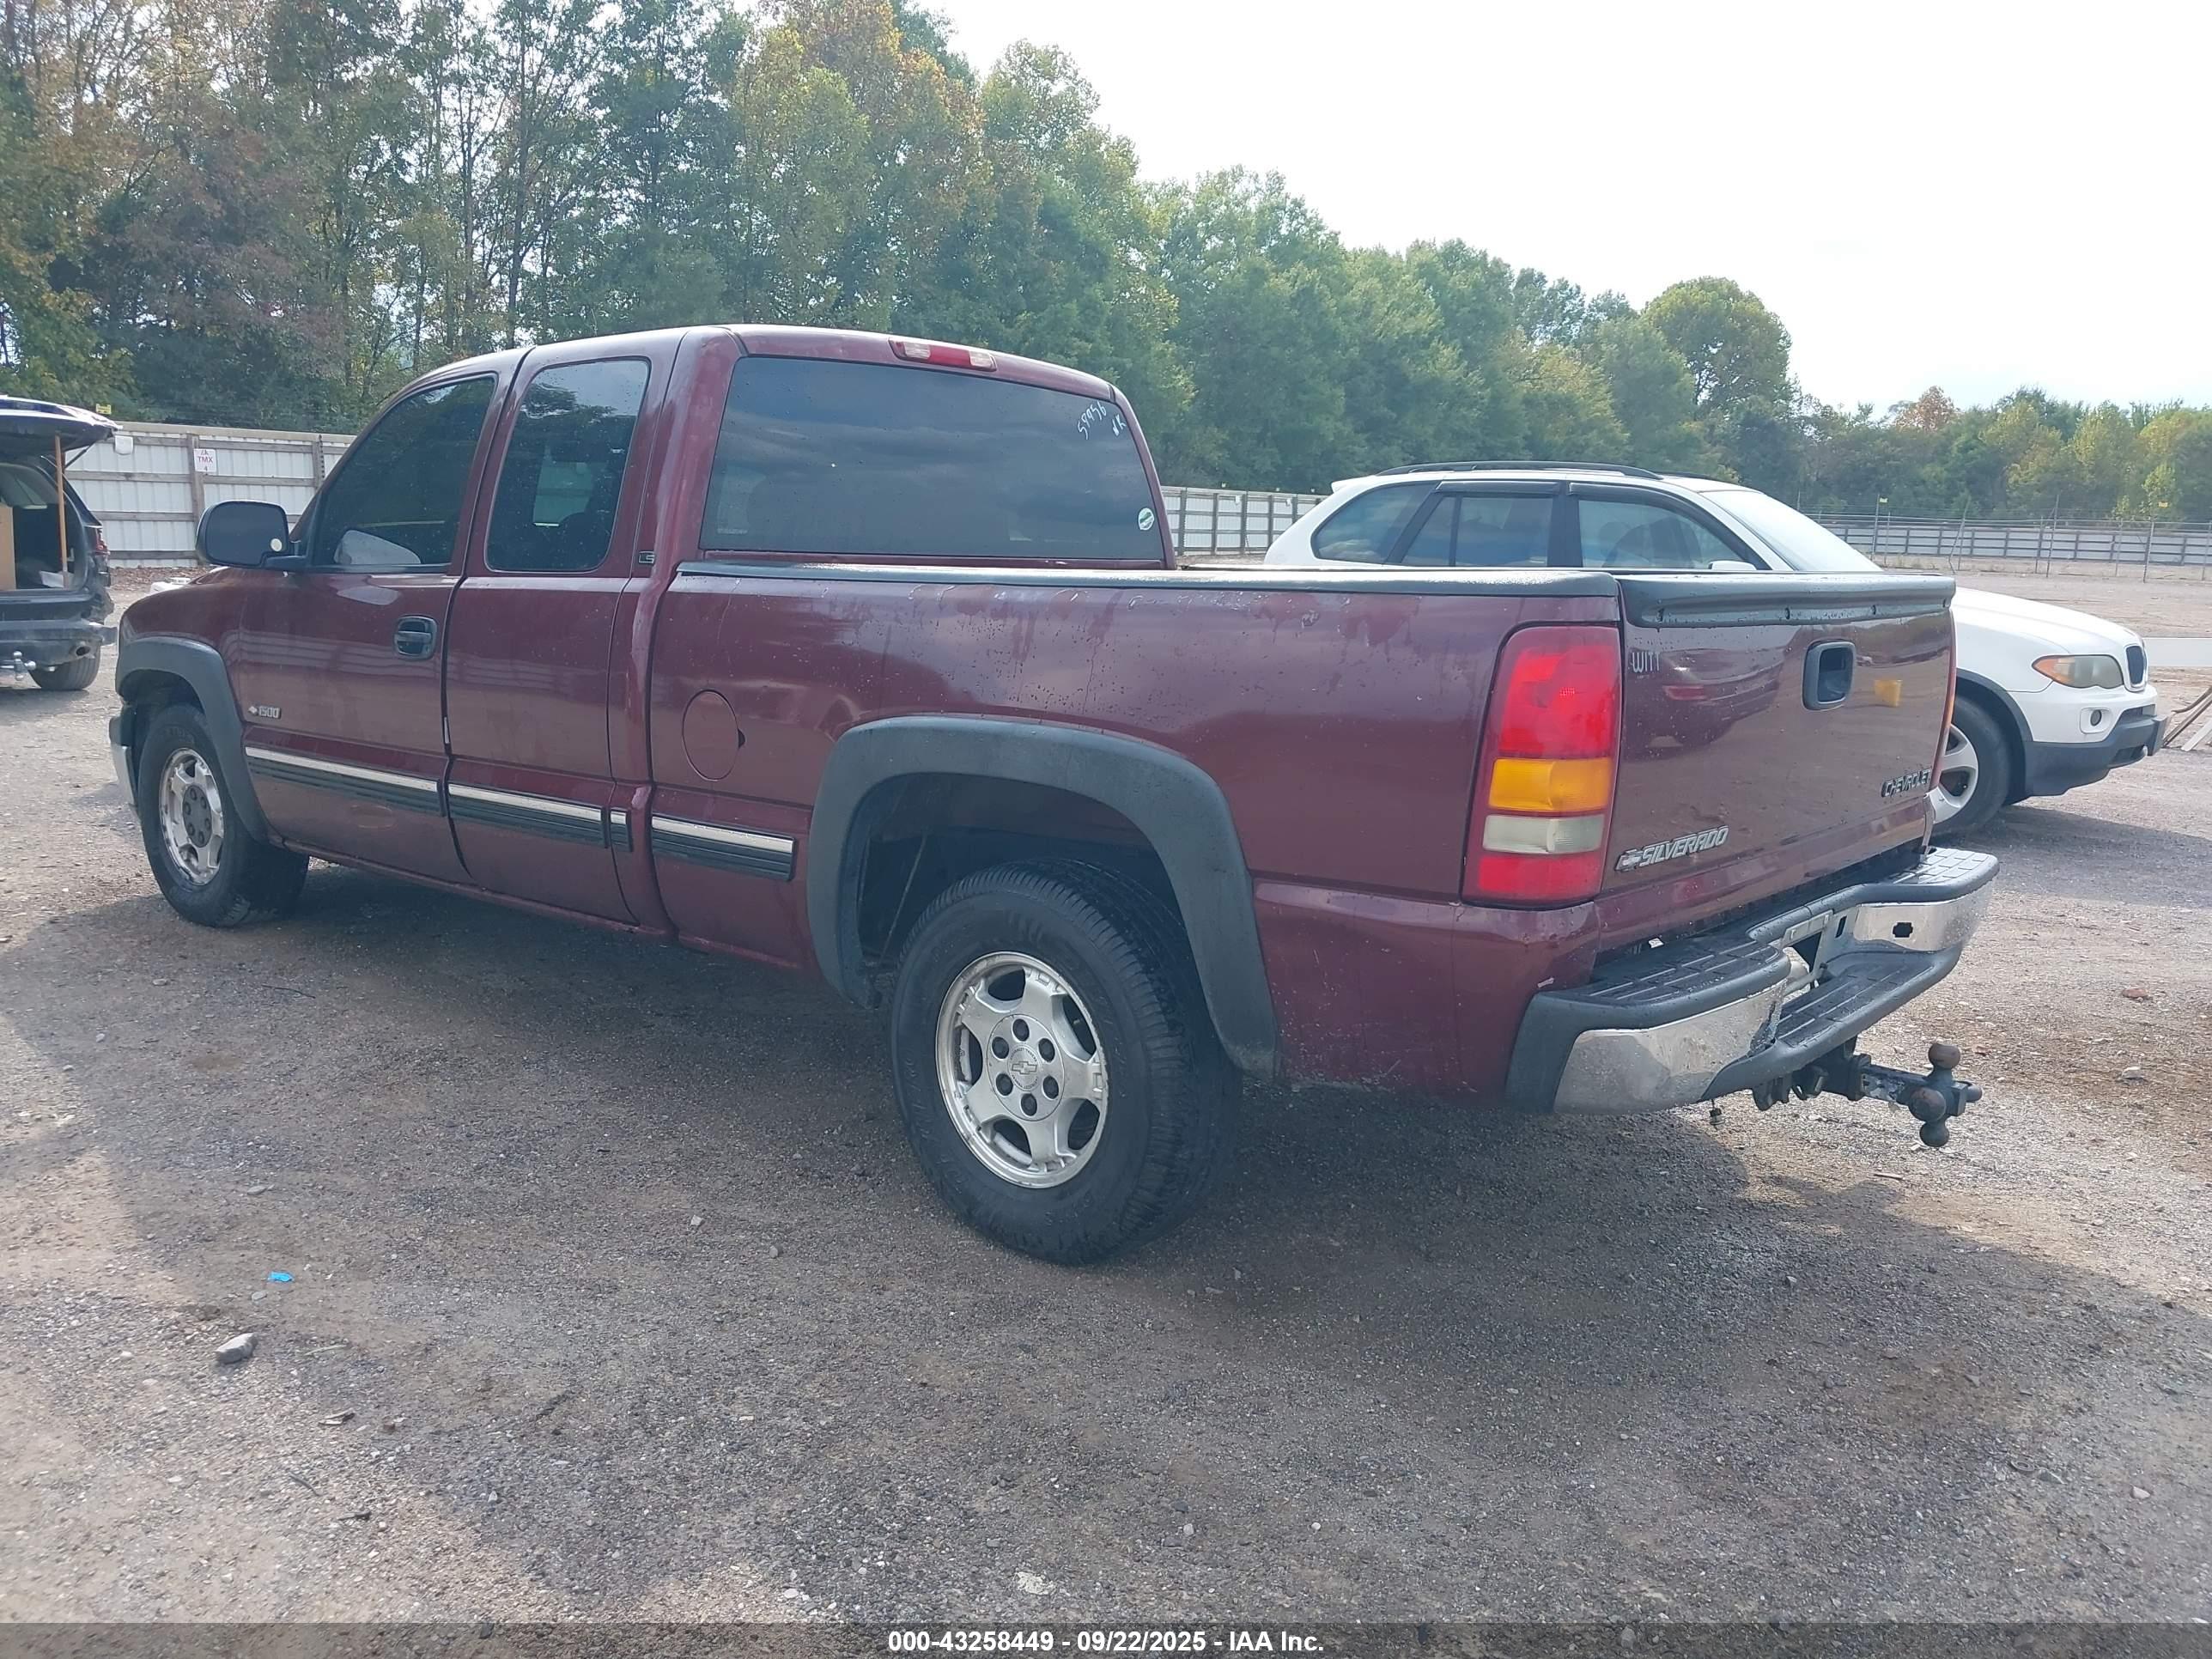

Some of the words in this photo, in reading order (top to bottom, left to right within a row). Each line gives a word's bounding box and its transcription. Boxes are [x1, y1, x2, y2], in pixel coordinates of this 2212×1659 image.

[198, 455, 213, 464] TMX
[639, 551, 655, 563] LS
[258, 705, 280, 719] 1500
[1884, 769, 1931, 797] CHEVROLET
[1639, 826, 1729, 867] SILVERADO
